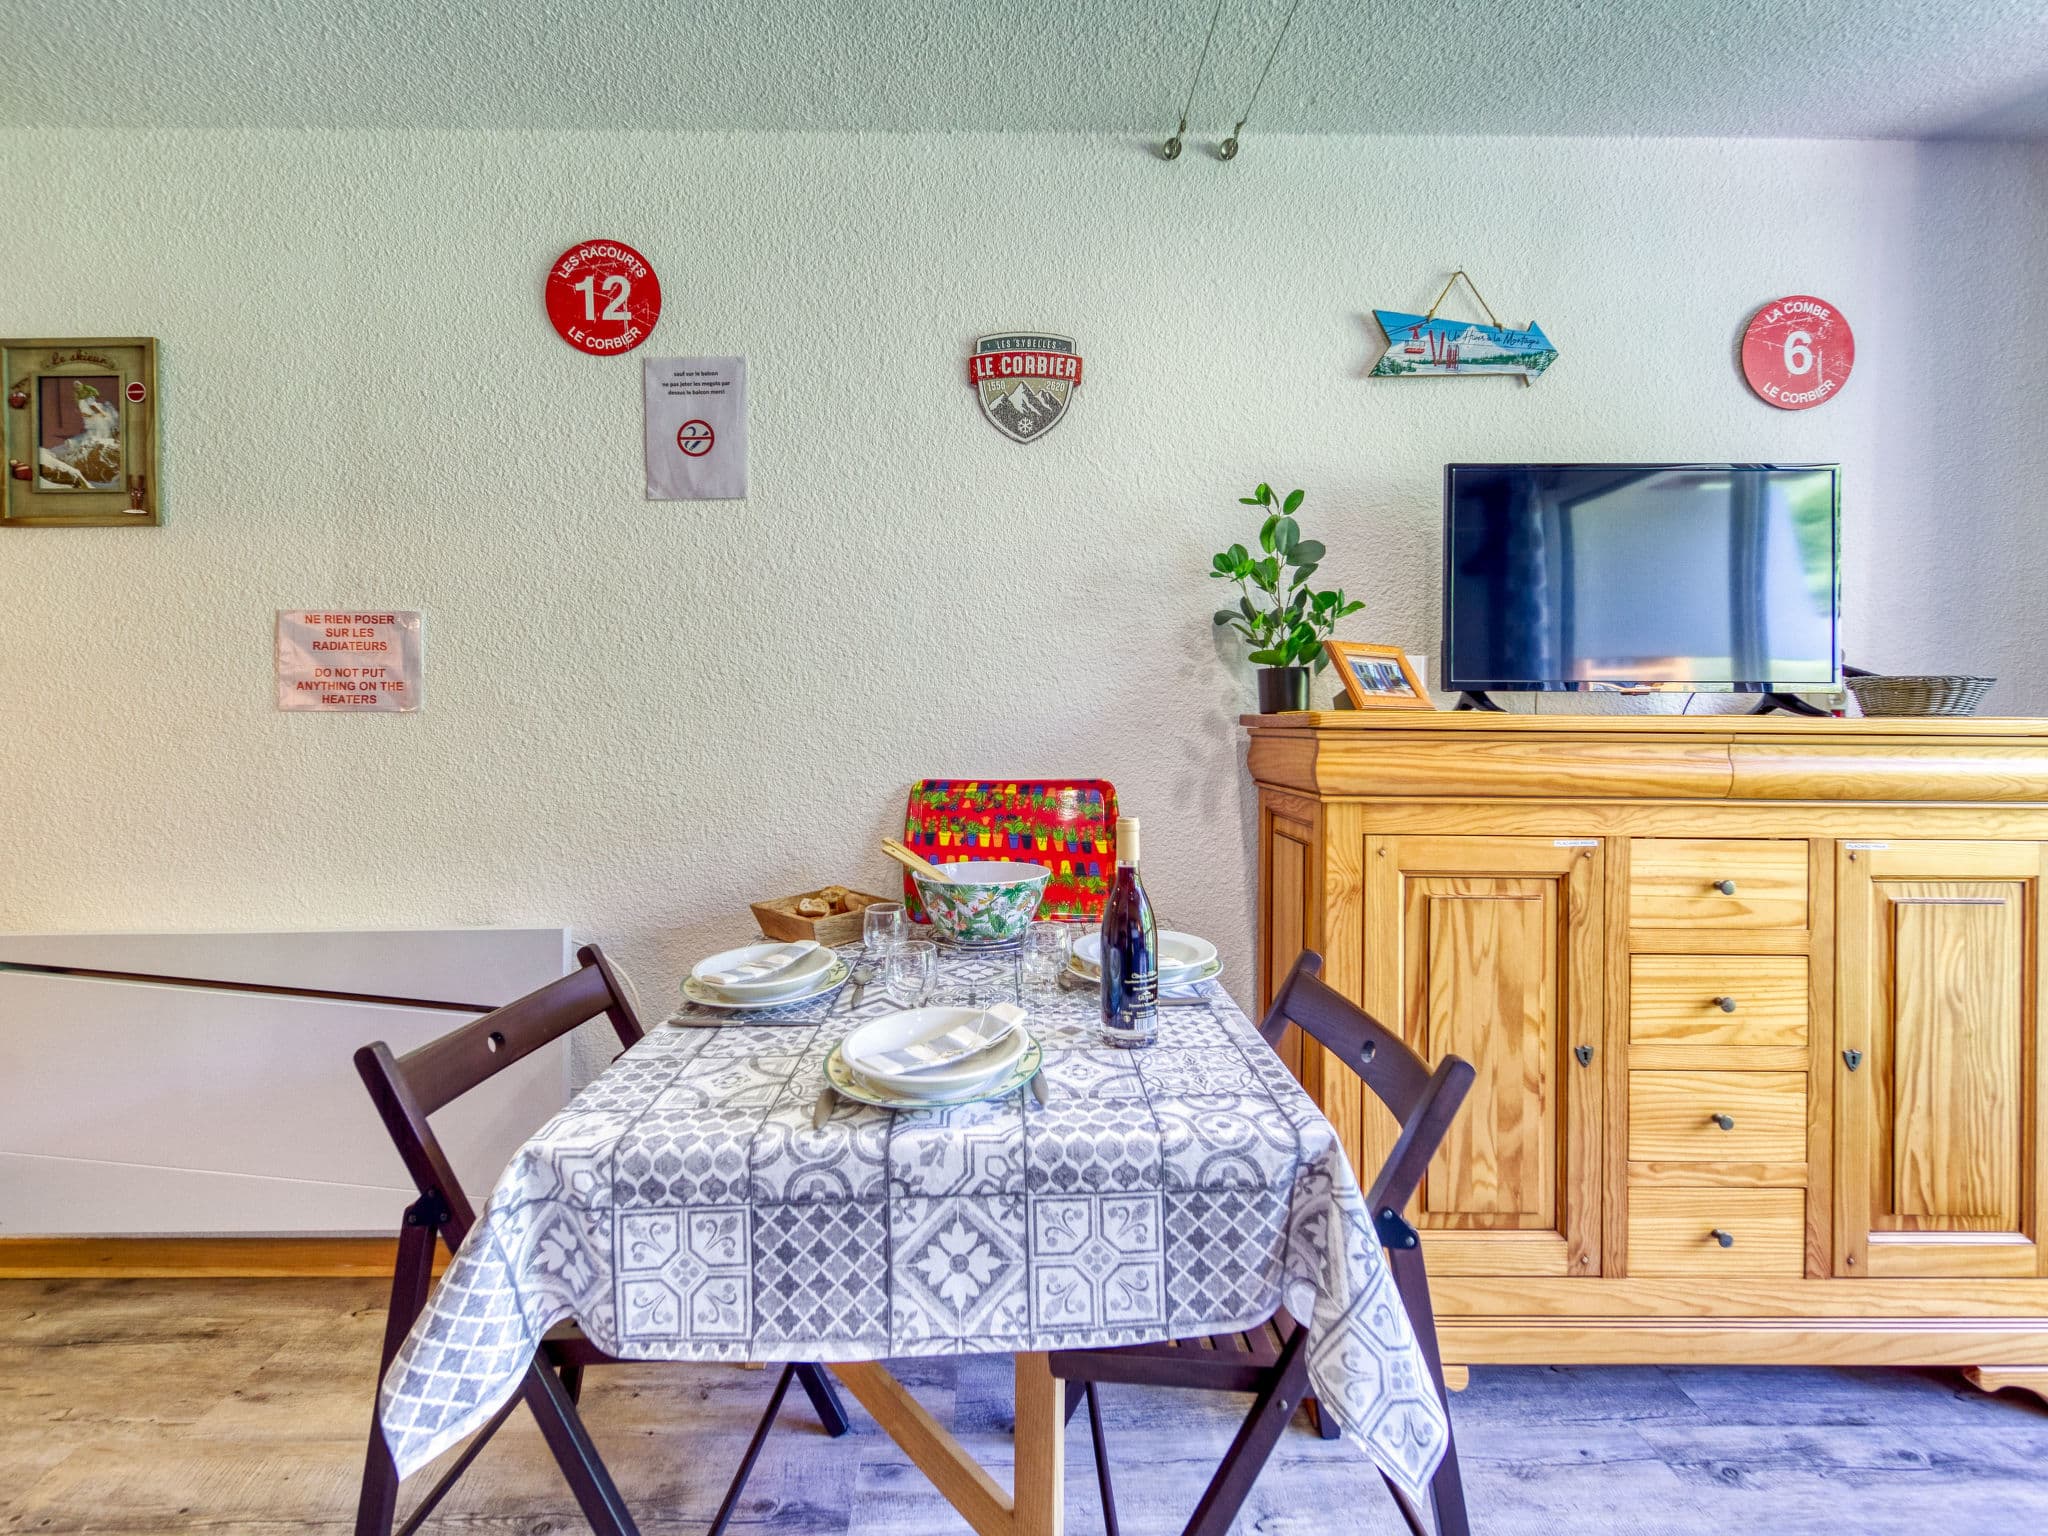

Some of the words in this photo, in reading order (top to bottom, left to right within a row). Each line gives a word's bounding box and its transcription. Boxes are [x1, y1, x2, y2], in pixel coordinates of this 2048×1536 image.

[558, 256, 579, 279] LES
[580, 246, 647, 278] RACOURTS
[575, 275, 632, 320] 12
[1765, 308, 1783, 323] LA
[1784, 302, 1830, 320] COMBE
[568, 326, 585, 343] LE
[586, 326, 641, 349] CORBIER
[997, 340, 1011, 349] LES
[1016, 339, 1056, 349] SYBELLES
[1784, 330, 1813, 375] 6
[976, 357, 994, 377] LE
[1001, 356, 1077, 377] CORBIER
[1763, 382, 1780, 398] LE
[1781, 379, 1835, 403] CORBIER
[305, 615, 321, 624] NE
[324, 615, 351, 624] RIEN
[355, 615, 395, 625] POSER
[326, 628, 349, 637] SUR
[353, 628, 375, 637] LES
[312, 641, 388, 651] RADIATEURS
[315, 669, 332, 678] DO
[335, 669, 359, 678] NOT
[362, 669, 386, 678] PUT
[296, 682, 356, 691] ANYTHING
[359, 682, 377, 691] ON
[381, 682, 404, 691] THE
[321, 695, 377, 704] HEATERS
